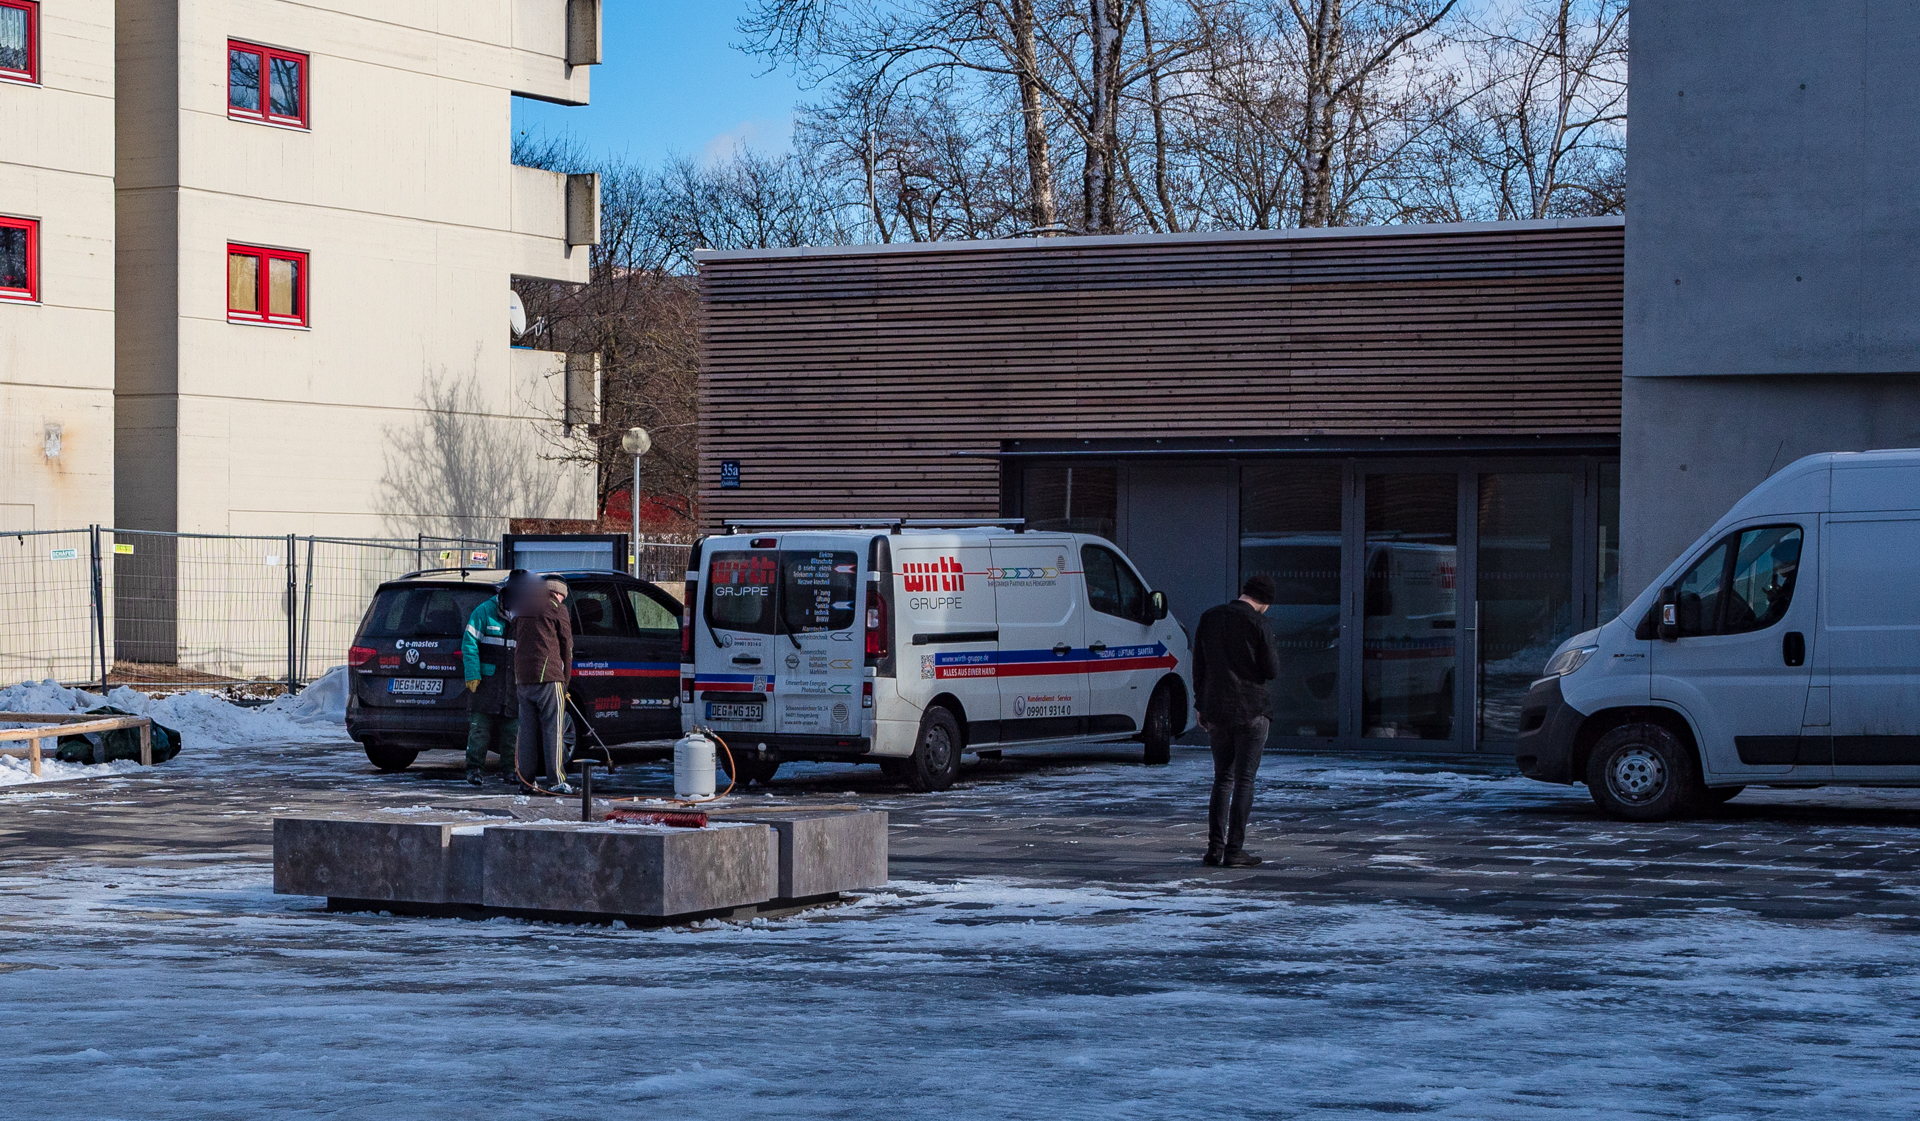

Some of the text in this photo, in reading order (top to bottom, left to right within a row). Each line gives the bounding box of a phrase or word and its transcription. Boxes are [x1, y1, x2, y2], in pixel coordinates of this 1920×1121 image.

[722, 463, 738, 476] 35a
[902, 556, 965, 592] wirth
[909, 597, 963, 610] GRUPPE
[405, 640, 439, 648] e-masters
[941, 653, 989, 663] www.wirth-gruppe.de
[943, 667, 996, 677] ALLES AUS EINER HAND
[393, 680, 442, 690] DEG WG 373
[595, 710, 619, 718] GRUPPE
[711, 704, 761, 718] DEG WG 151
[1026, 706, 1047, 717] 09901
[1048, 705, 1065, 716] 9314
